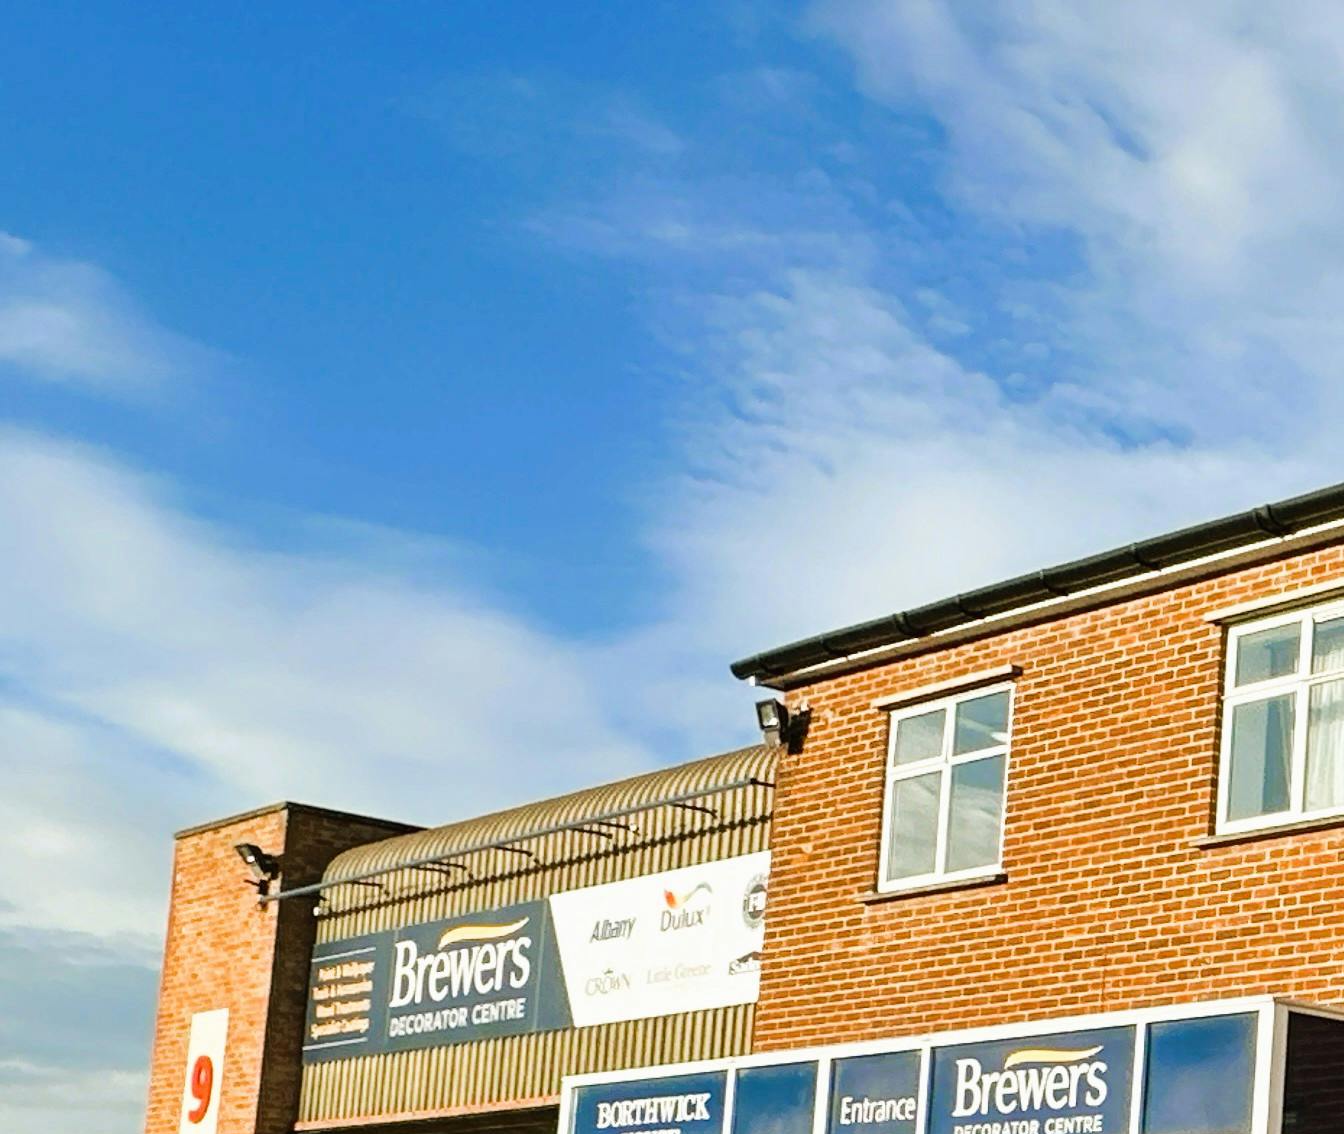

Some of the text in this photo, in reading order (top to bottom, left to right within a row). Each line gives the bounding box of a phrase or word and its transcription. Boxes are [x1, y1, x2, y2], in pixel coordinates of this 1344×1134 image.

[589, 917, 637, 943] Albany
[660, 908, 704, 932] Dulux
[389, 937, 532, 1008] Brewers
[389, 1007, 468, 1038] DECORATOR
[471, 998, 527, 1025] CENTRE
[188, 1054, 214, 1124] 9
[952, 1058, 1108, 1118] Brewers
[596, 1092, 712, 1129] BORTHWICK
[839, 1095, 916, 1126] Entrance
